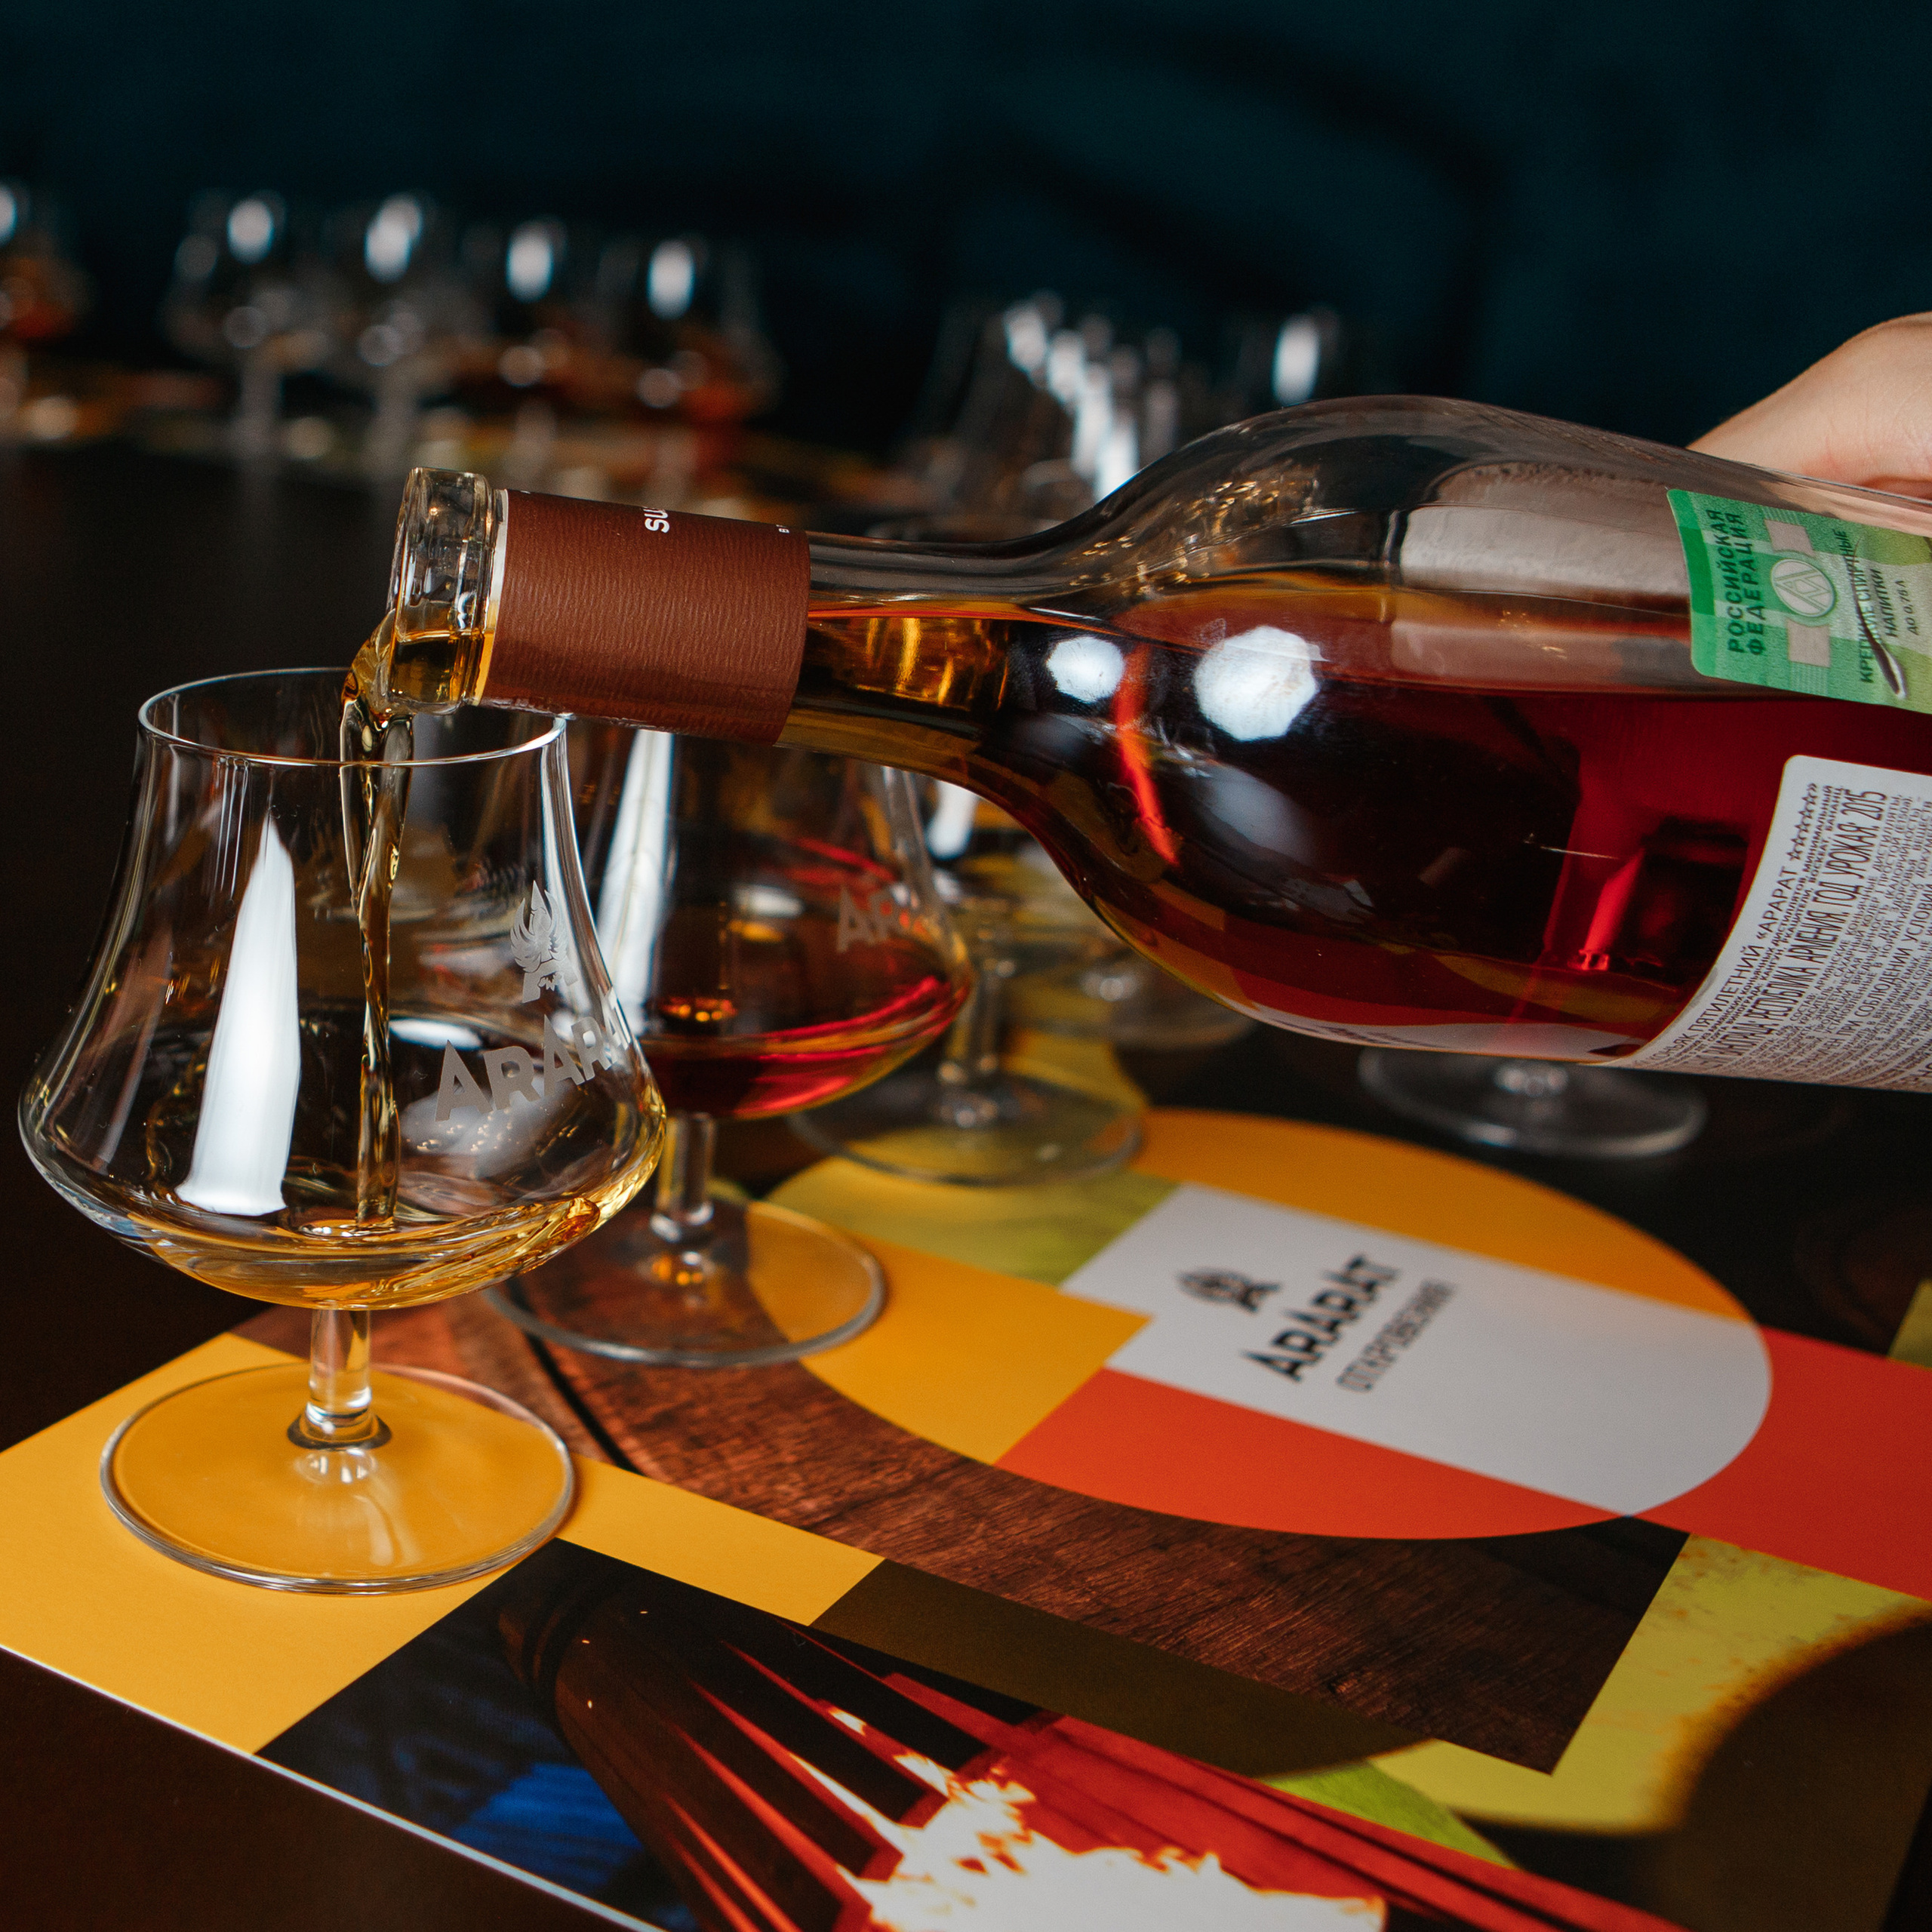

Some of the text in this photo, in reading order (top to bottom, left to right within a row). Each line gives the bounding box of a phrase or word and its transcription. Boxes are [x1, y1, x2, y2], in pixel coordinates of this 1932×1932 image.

[642, 506, 669, 533] SU
[1706, 509, 1746, 654] РОССИЙСКАЯ
[1724, 512, 1766, 656] ФЕДЕРАЦИЯ
[1869, 568, 1899, 638] НАПИТКИ
[1821, 820, 1878, 878] УРОЖАЯ:
[1839, 789, 1887, 820] 2015
[1687, 944, 1764, 1032] ПЯТИЛЕТНИЙ
[1753, 866, 1799, 940] «АРАРАТ
[1738, 947, 1775, 995] КОНЬЯЧНЫХ
[1801, 784, 1832, 872] МИНИМАЛЬНЫЙ
[1783, 907, 1849, 964] АРМЕНИЯ.
[1787, 992, 1818, 1021] СОСТАВ:
[1812, 940, 1850, 989] АРМЯНСКИЕ
[1844, 875, 1878, 936] КОНЬЯЧНЫЕ
[1797, 986, 1834, 1024] КРАСИТЕЛЬ
[1832, 929, 1866, 977] САХАРНЫЙ
[1860, 897, 1881, 927] КОЛЕР
[1877, 836, 1902, 887] ПРОСТОЙ
[1810, 879, 1863, 906] ГОД
[1811, 989, 1854, 1032] ПРОДУКЦИИ
[1850, 946, 1881, 985] ВРЕДНЫХ
[1877, 919, 1893, 939] ДЛЯ
[1888, 859, 1917, 912] ЗДОРОВЬЯ
[1810, 957, 1863, 1021] ЭНЕРГЕТИЧЕСКАЯ
[1858, 903, 1889, 952] ЦЕННОСТЬ
[1822, 971, 1878, 1033] УСТАНОВЛЕННЫЕ
[1878, 883, 1920, 958] НОРМАТИВНЫХ
[1834, 1020, 1863, 1035] ПРИ
[1851, 947, 1913, 1017] СОБЛЮДЕНИИ
[1241, 1253, 1401, 1383] ARARAT
